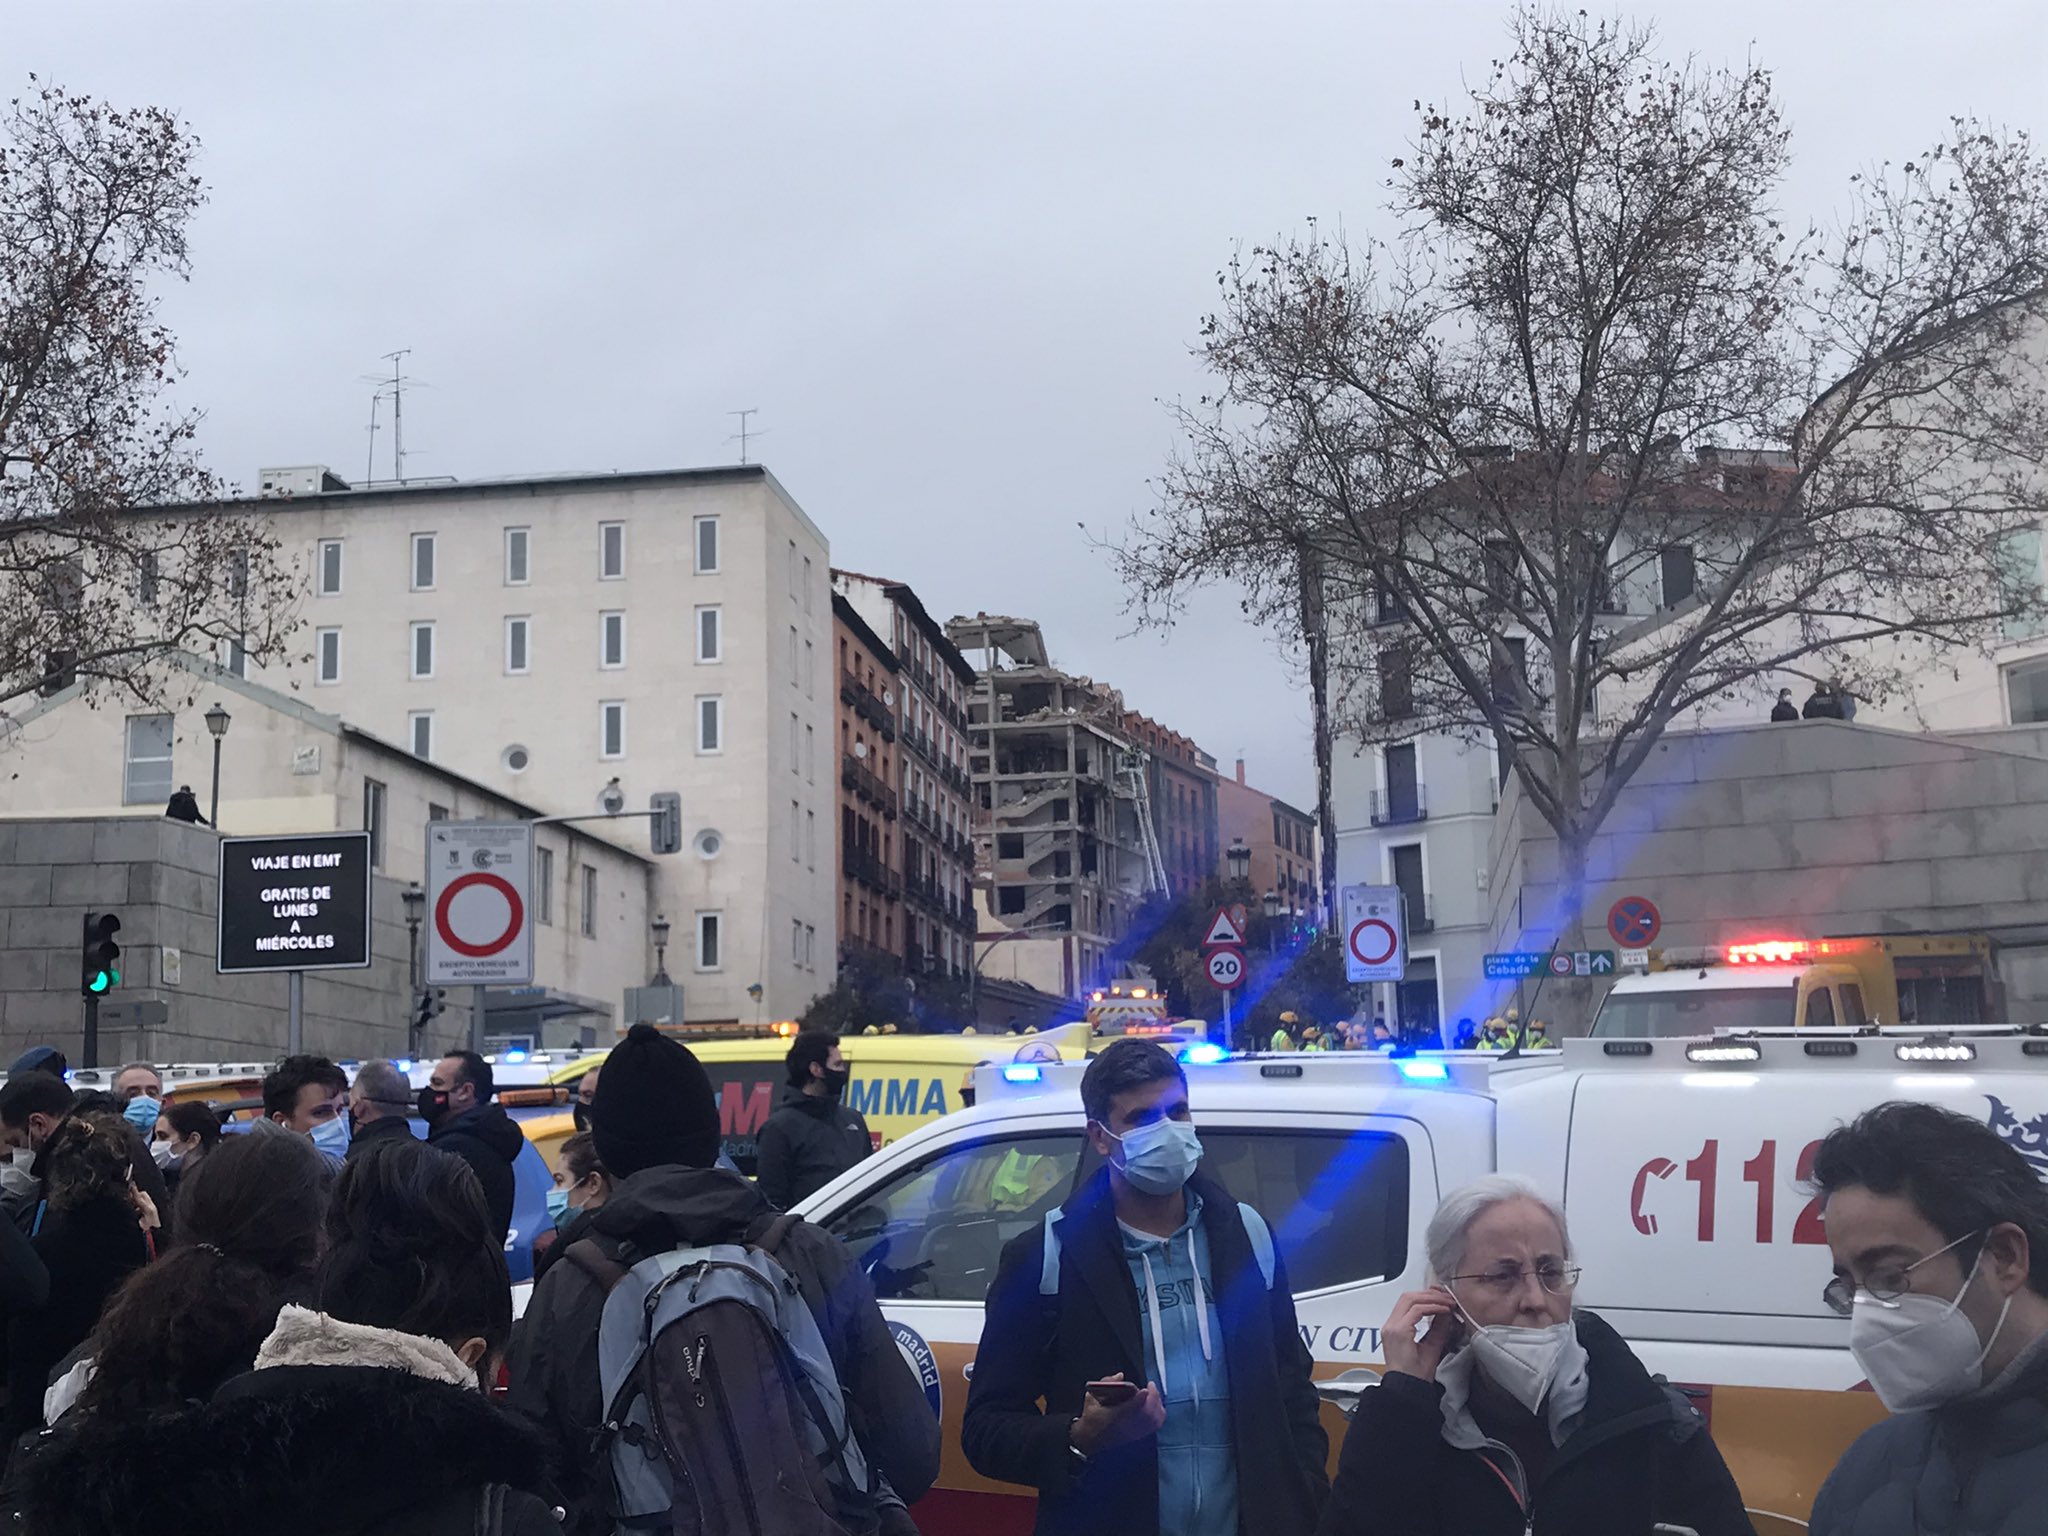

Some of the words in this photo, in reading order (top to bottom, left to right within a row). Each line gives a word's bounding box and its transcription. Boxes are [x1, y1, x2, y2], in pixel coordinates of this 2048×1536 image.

[251, 854, 289, 870] VIAJE
[292, 854, 311, 868] EN
[313, 853, 341, 868] EMT
[261, 887, 309, 902] GRATIS
[312, 886, 331, 900] DE
[273, 904, 318, 918] LUNES
[290, 920, 300, 933] A
[256, 934, 334, 951] MIÉRCOLES
[1213, 960, 1238, 975] 20
[841, 1078, 948, 1116] MMA
[896, 1329, 938, 1387] madrid
